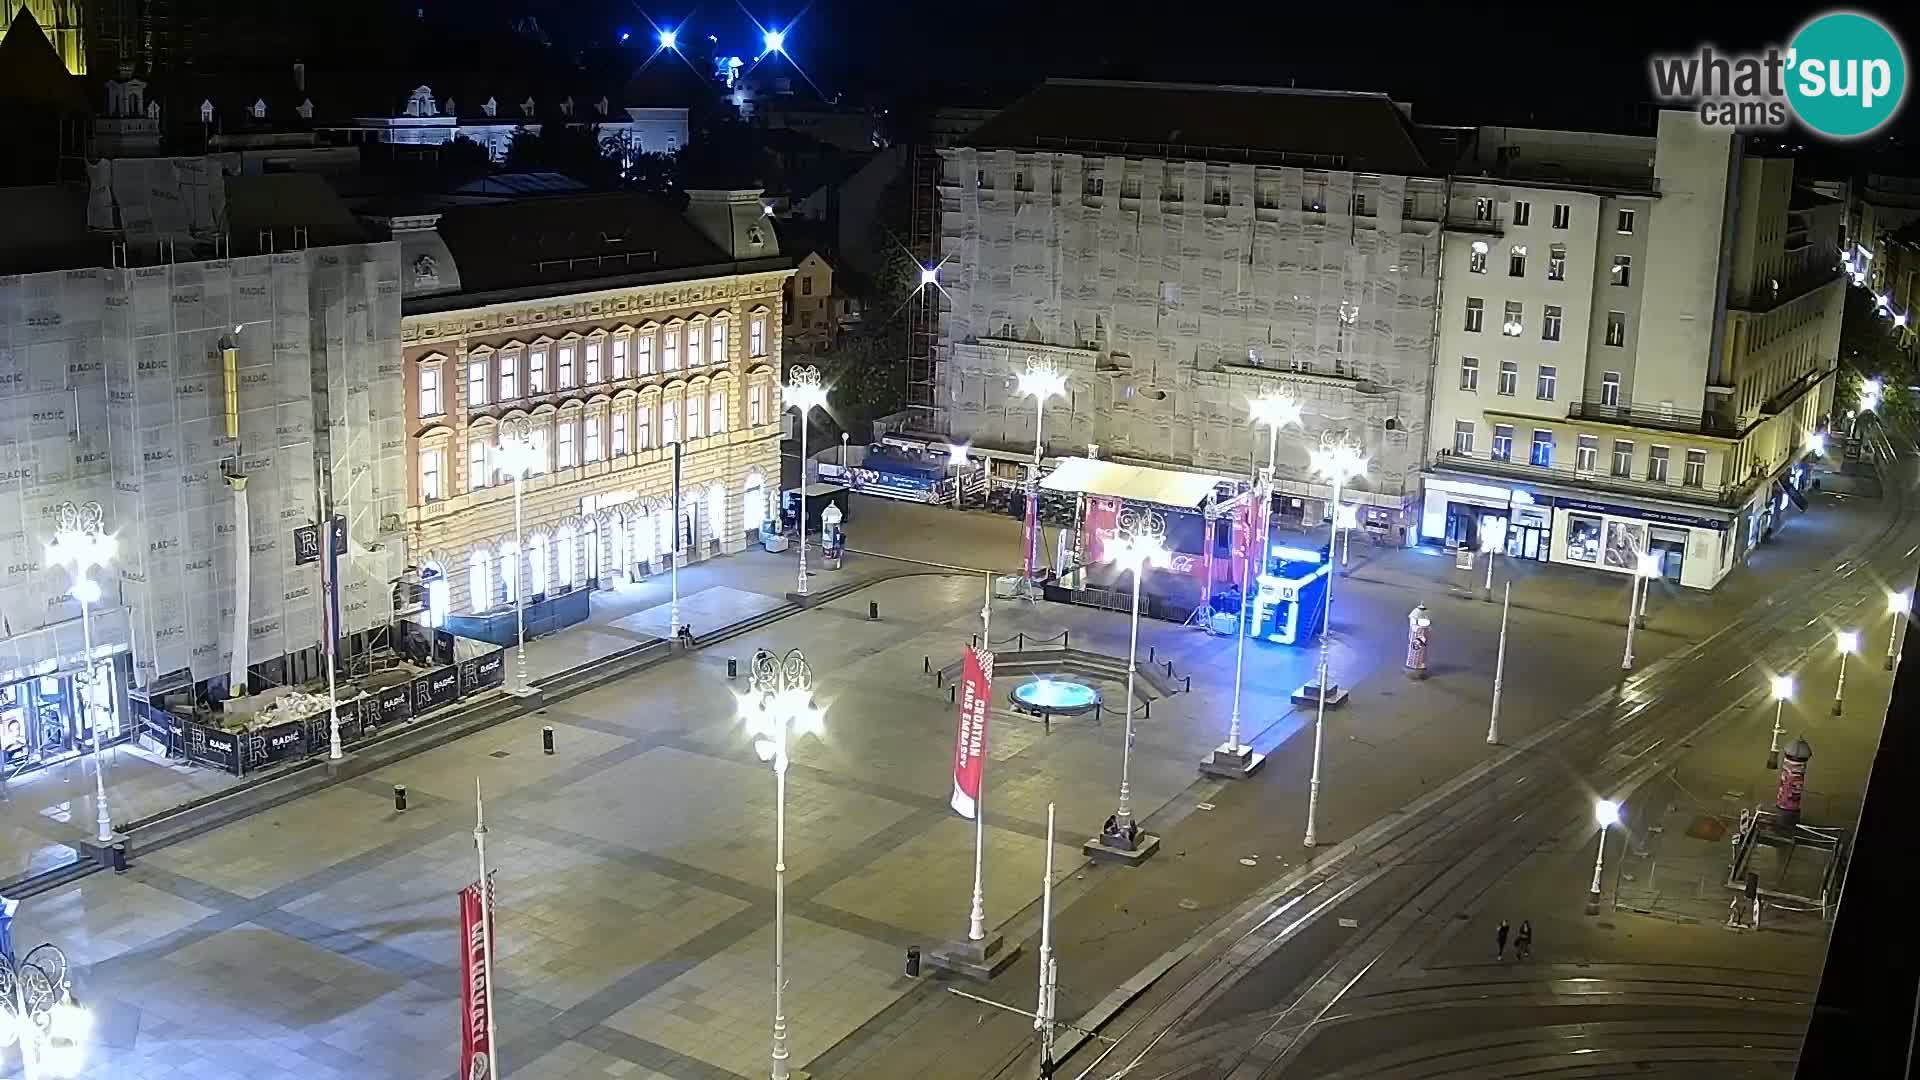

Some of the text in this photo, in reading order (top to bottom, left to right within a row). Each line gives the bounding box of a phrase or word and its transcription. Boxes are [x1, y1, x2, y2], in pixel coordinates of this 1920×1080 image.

[960, 679, 976, 769] FANS EMBASSY
[969, 699, 985, 757] CROATIAN
